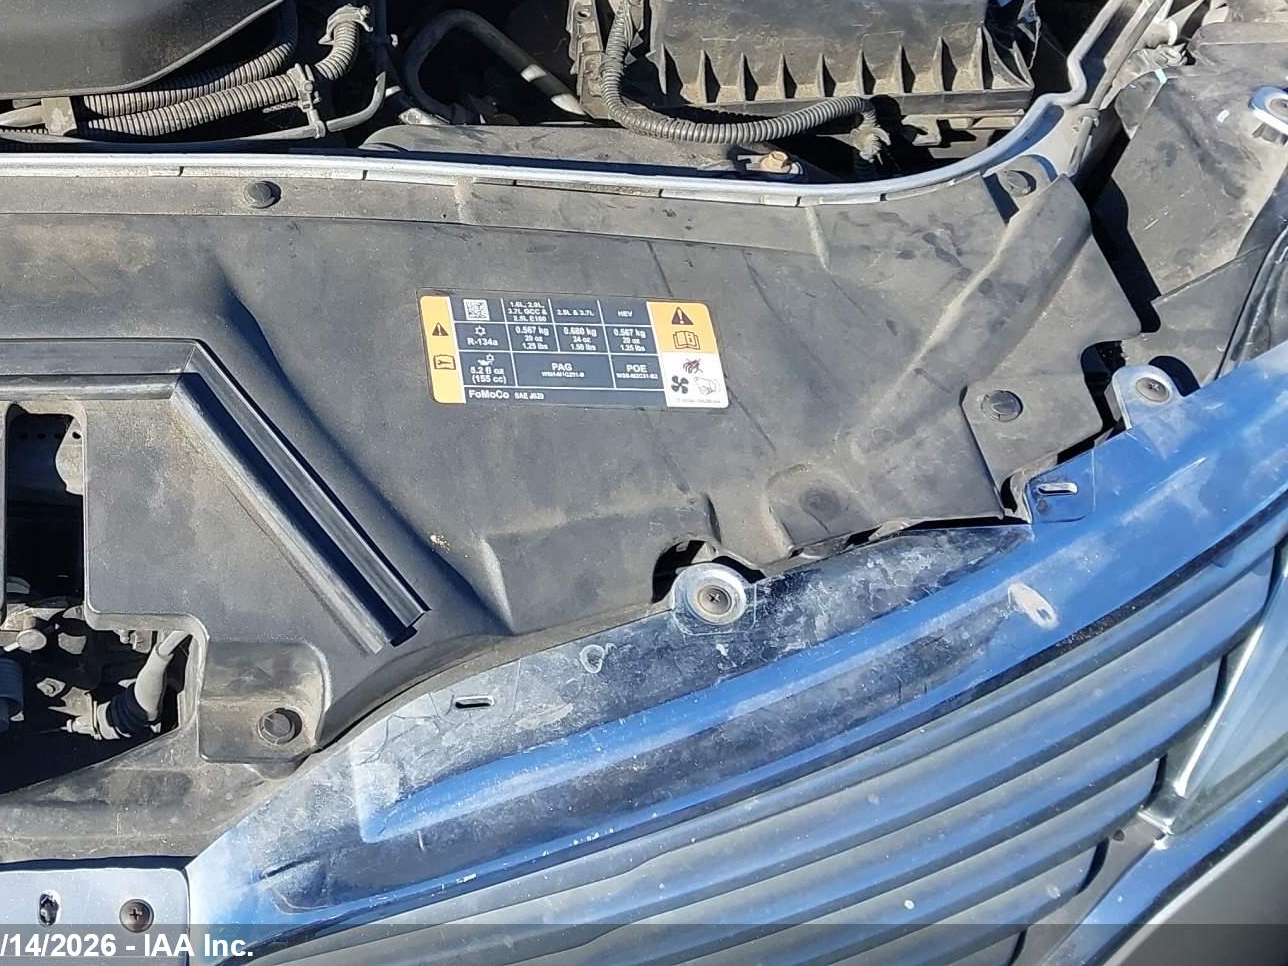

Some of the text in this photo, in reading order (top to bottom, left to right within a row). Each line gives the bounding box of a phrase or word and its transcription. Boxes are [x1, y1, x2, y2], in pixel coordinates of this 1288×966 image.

[515, 326, 550, 336] 0.567 kg
[586, 327, 597, 337] kg
[635, 328, 646, 338] kg
[467, 338, 499, 346] R-134a
[551, 362, 573, 372] PAG
[626, 364, 648, 373] POE
[472, 375, 507, 384] (155 cc)
[468, 389, 510, 399] FoMoCo
